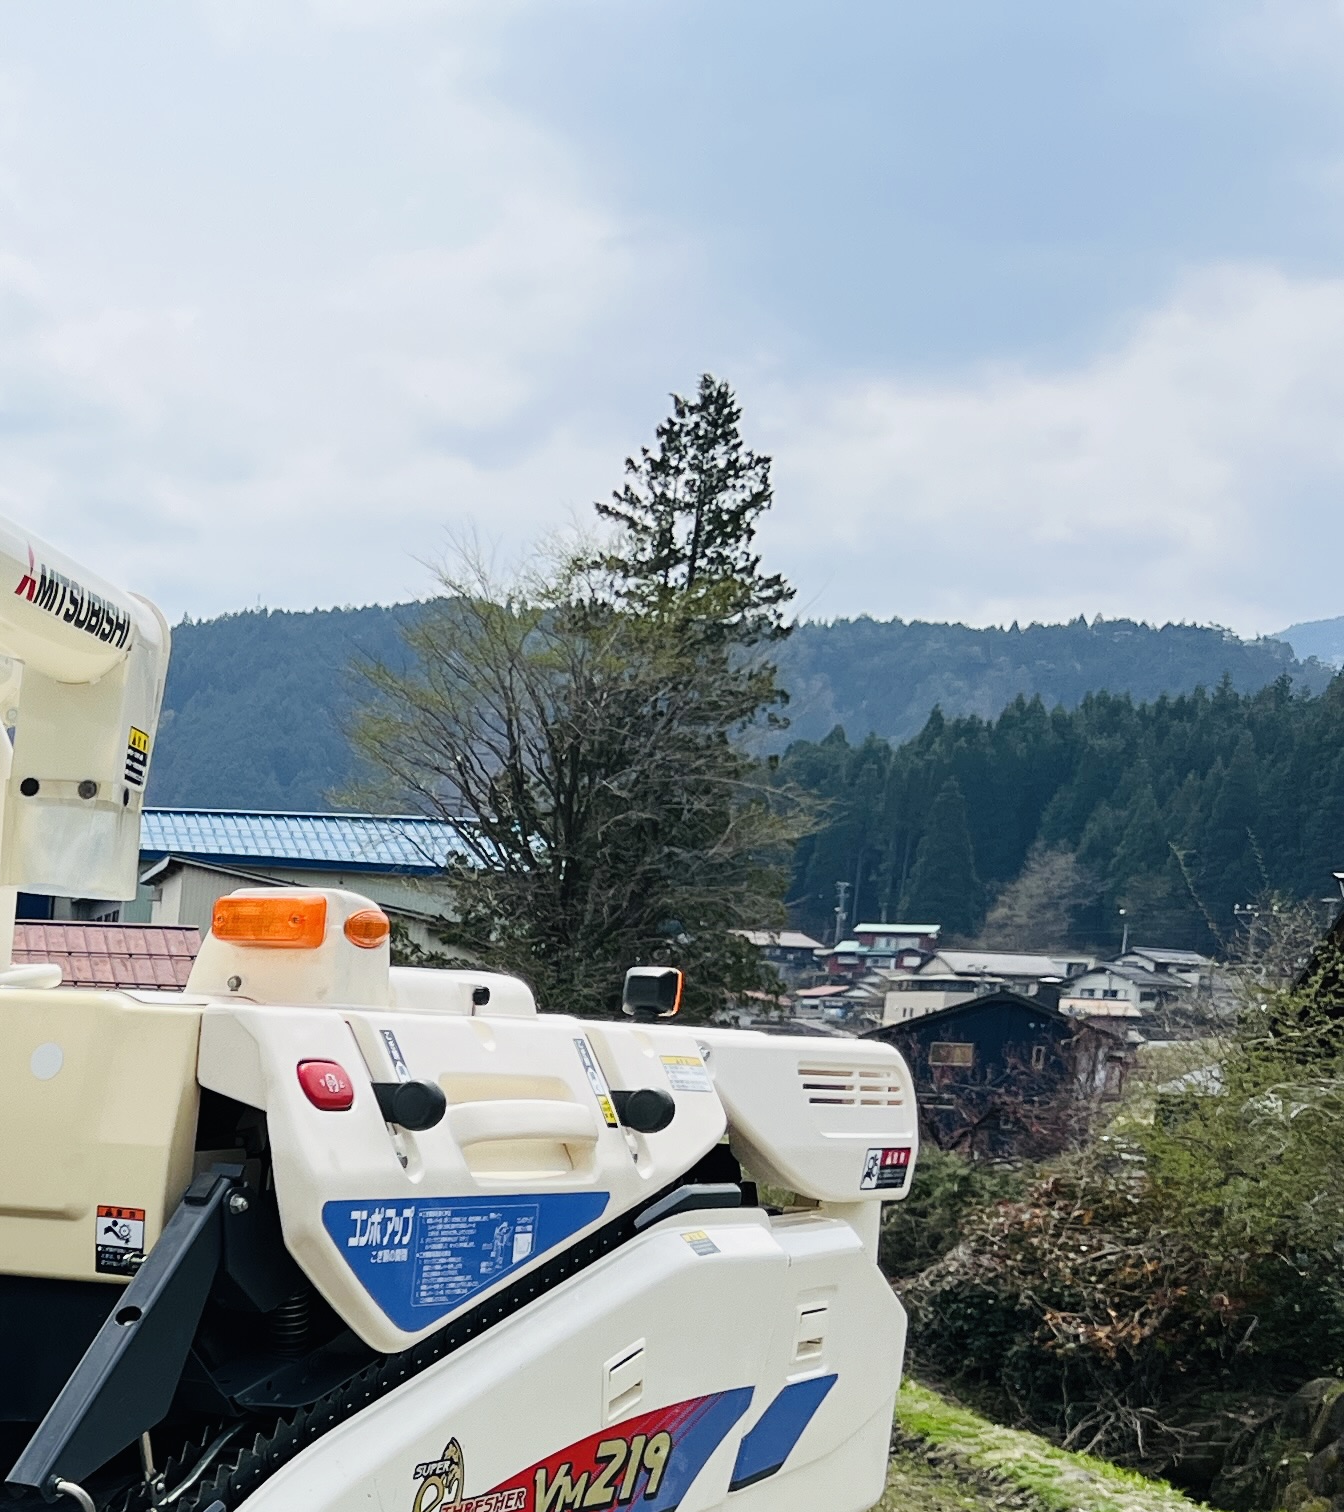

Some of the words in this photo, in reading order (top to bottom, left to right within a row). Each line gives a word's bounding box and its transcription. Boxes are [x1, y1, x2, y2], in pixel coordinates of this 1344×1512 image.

[33, 564, 131, 649] MITSUBISHI
[348, 1206, 415, 1247] コンボアップ
[413, 1460, 450, 1480] SUPER
